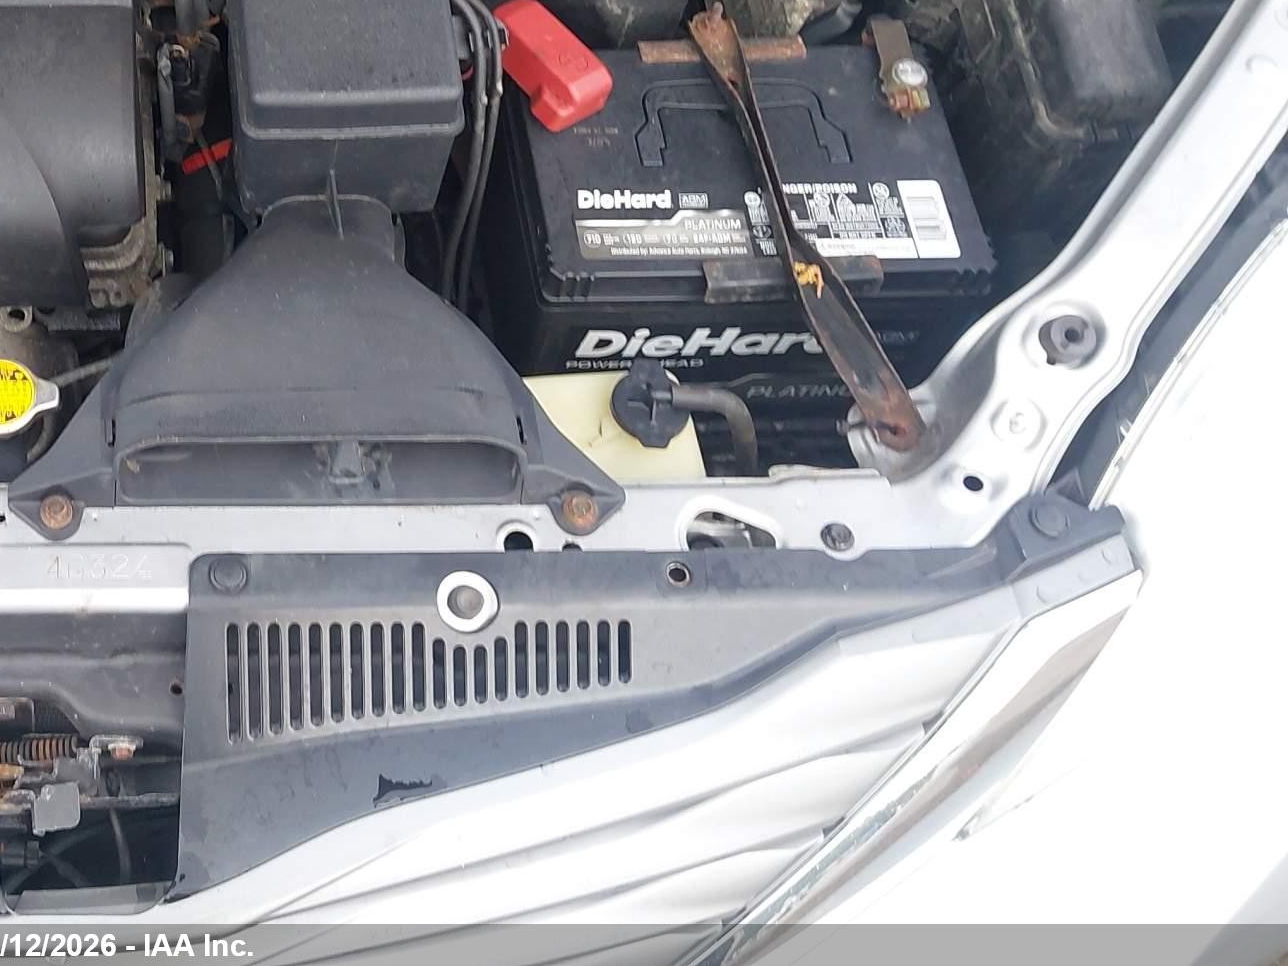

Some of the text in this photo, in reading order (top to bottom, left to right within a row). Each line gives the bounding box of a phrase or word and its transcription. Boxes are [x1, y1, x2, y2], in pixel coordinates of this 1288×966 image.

[577, 189, 672, 209] DieHard
[684, 218, 741, 231] PLATINUM
[747, 385, 850, 399] PLATINU
